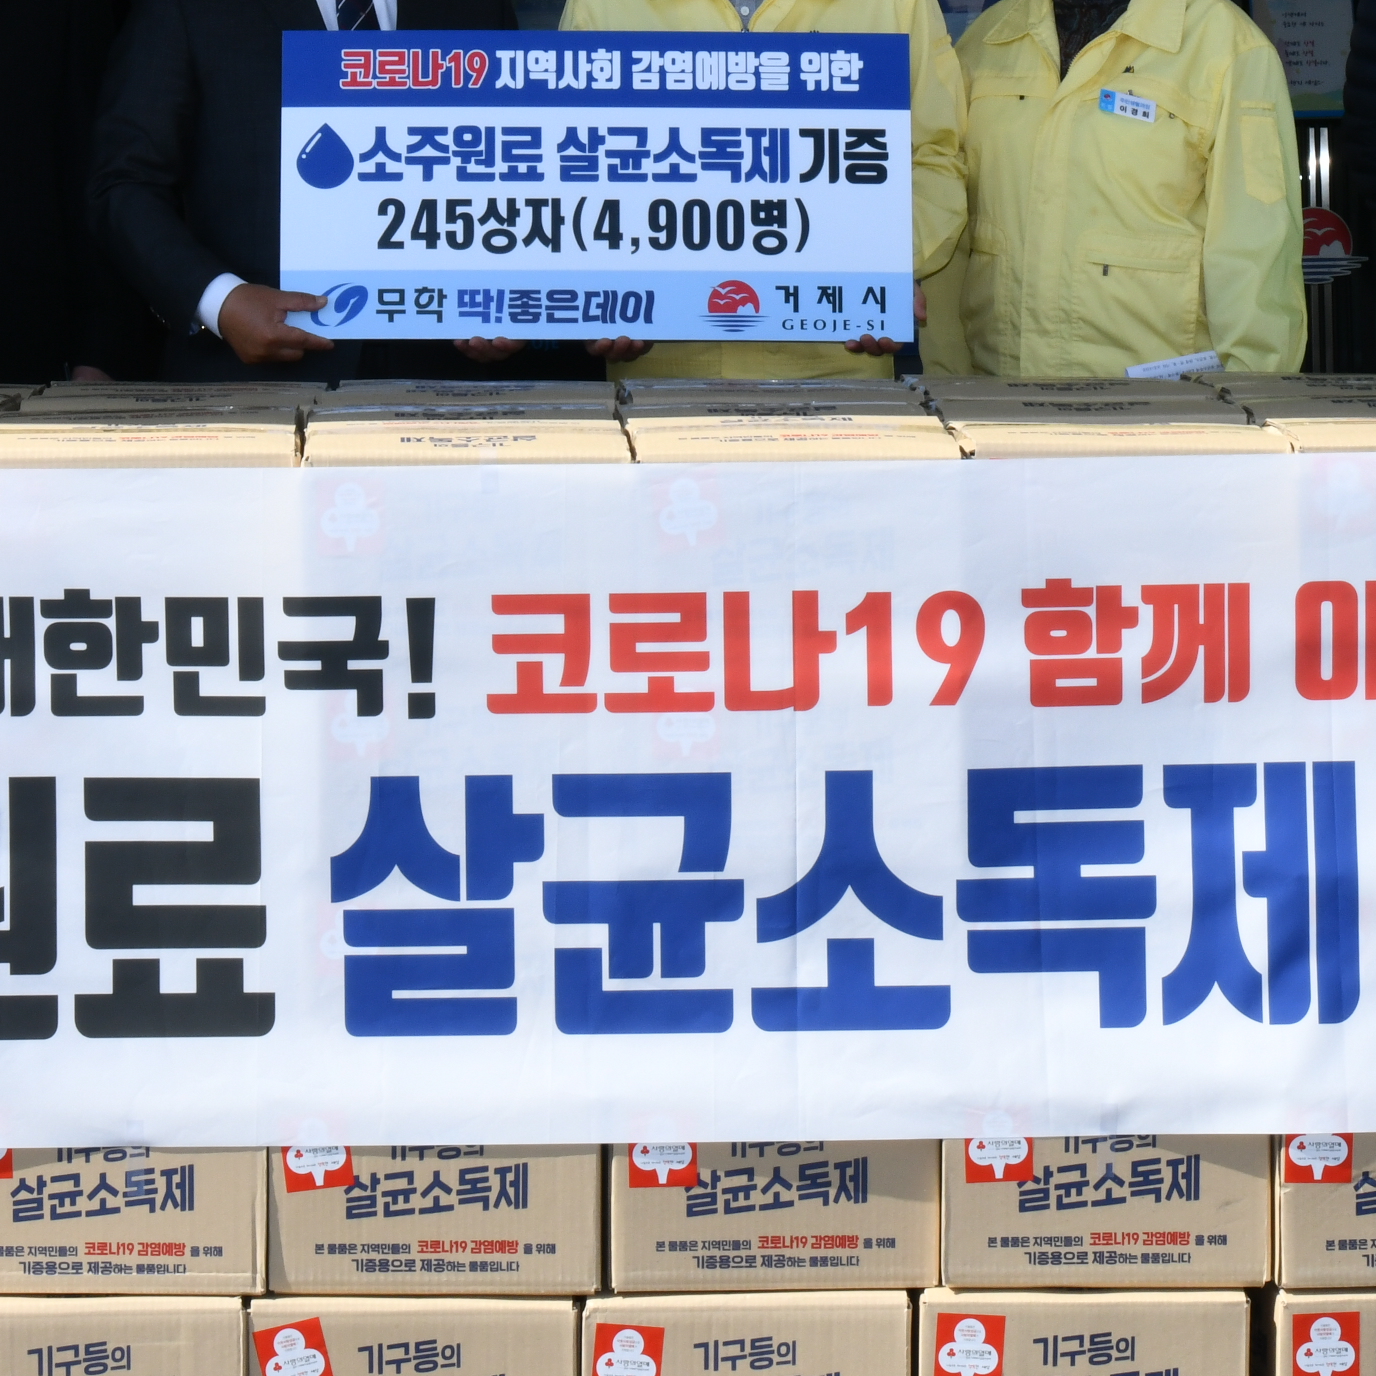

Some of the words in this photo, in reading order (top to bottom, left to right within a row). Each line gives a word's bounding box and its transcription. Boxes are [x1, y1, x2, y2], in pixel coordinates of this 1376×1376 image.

[339, 48, 489, 91] 코로나19
[495, 49, 621, 91] 지역사회
[632, 49, 790, 92] 감염예방을
[800, 50, 864, 92] 위한
[357, 125, 544, 184] 소주원료
[557, 126, 791, 184] 살균소독제
[799, 127, 890, 185] 기증
[377, 196, 810, 256] 245상자(4,900병)
[375, 286, 449, 324] 무학
[781, 317, 886, 332] GEOJE-SI
[486, 590, 986, 715] 코로나19
[1021, 577, 1252, 709] 함께
[329, 759, 1361, 1038] 살균소독제
[10, 1162, 195, 1223] 살균소독제
[344, 1162, 529, 1220] 살균소독제
[684, 1155, 869, 1218] 살균소독제
[315, 1243, 324, 1255] 본
[327, 1243, 358, 1255] 물품은
[360, 1243, 410, 1255] 지역민들의
[417, 1239, 467, 1255] 코로나19
[470, 1239, 519, 1255] 감염예방
[536, 1243, 556, 1254] 위해
[352, 1258, 416, 1273] 기증용으로
[420, 1258, 466, 1273] 제공하는
[469, 1259, 519, 1272] 물품입니다
[28, 1342, 130, 1376] 기구등의
[358, 1340, 460, 1374] 기구등의
[1033, 1332, 1135, 1366] 기구등의
